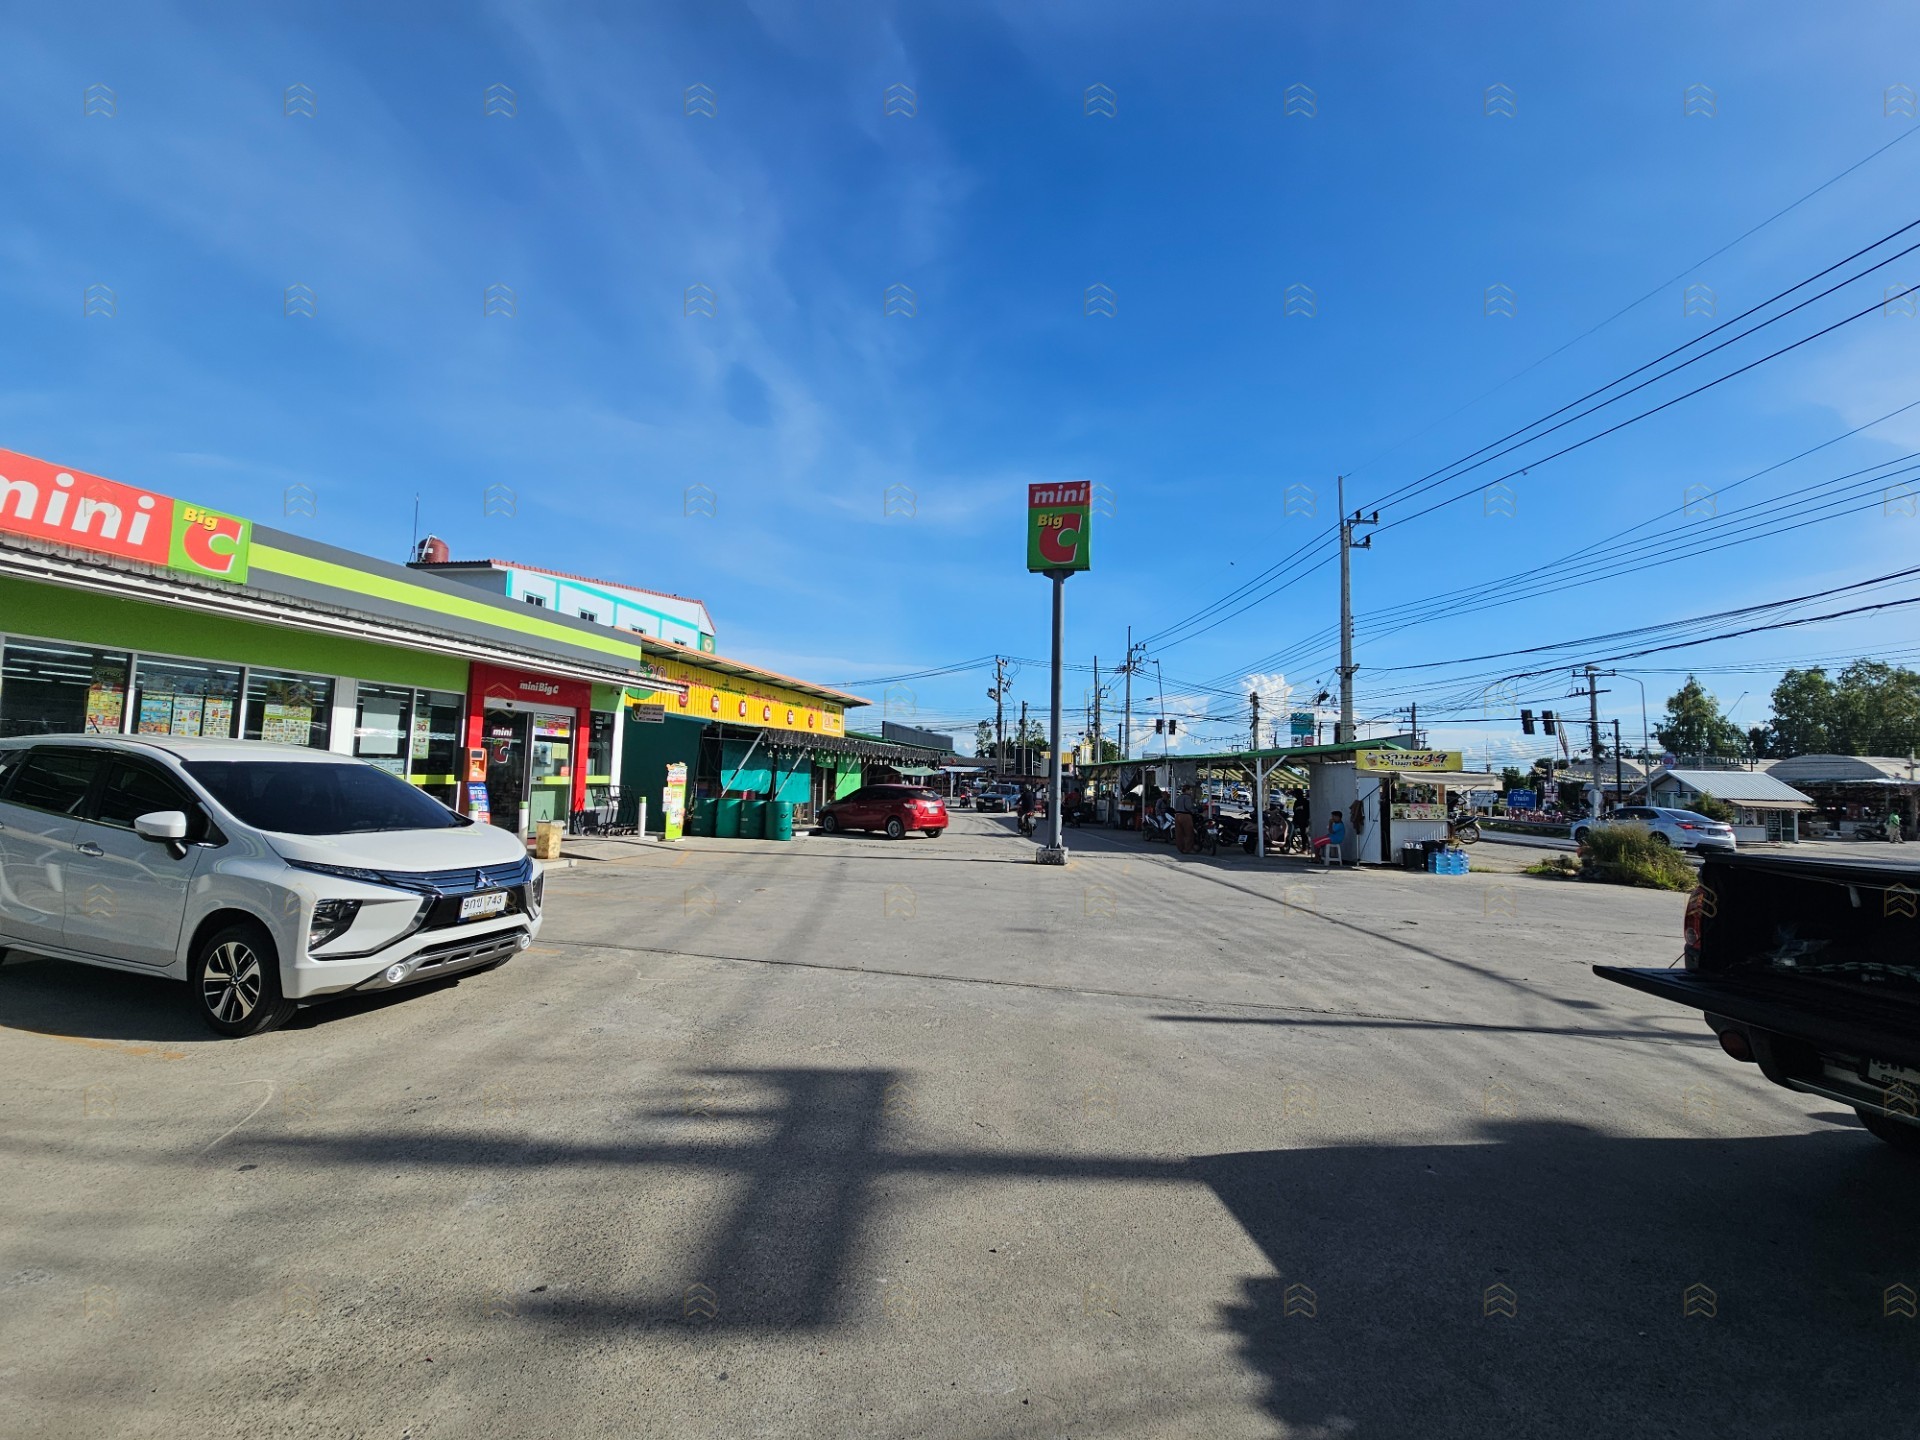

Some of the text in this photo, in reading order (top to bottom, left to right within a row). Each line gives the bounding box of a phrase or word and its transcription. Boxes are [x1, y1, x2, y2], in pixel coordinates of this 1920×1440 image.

[1034, 483, 1086, 504] mini
[183, 507, 218, 531] Big
[1038, 513, 1064, 529] Big
[184, 516, 244, 573] C
[1039, 513, 1082, 564] C
[519, 681, 559, 695] mini Big C
[492, 727, 513, 736] mini
[487, 895, 503, 906] 743
